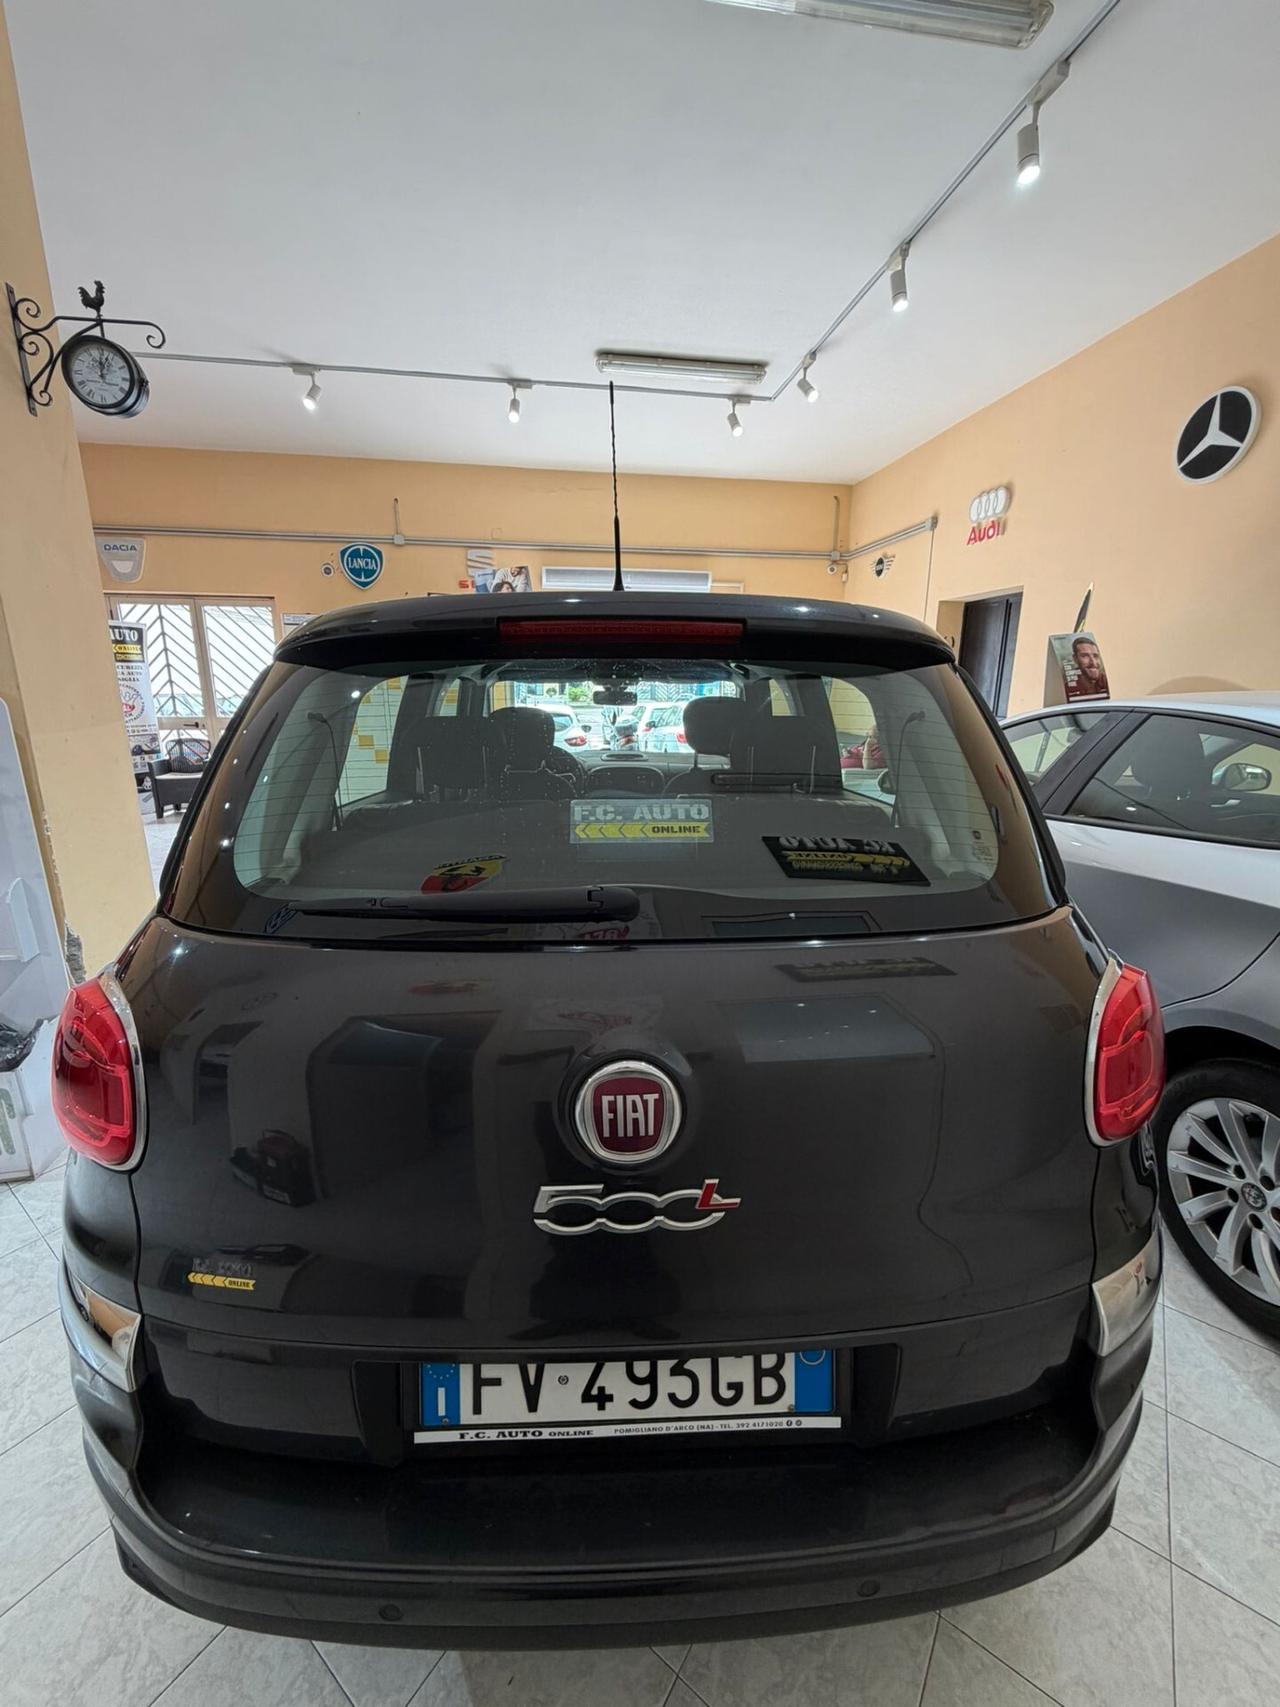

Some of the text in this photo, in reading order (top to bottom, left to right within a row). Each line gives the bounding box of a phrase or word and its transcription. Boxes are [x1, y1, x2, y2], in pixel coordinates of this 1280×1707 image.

[966, 519, 1001, 546] Audi
[103, 543, 138, 552] DACIA
[347, 557, 378, 570] LANCIA
[574, 803, 710, 820] F.C. AUTO
[651, 825, 701, 834] ONLINE
[601, 1093, 659, 1138] FIAT
[496, 1429, 543, 1439] AUTO
[548, 1429, 595, 1437] ONLINE
[613, 1426, 664, 1435] POMIGLIANO
